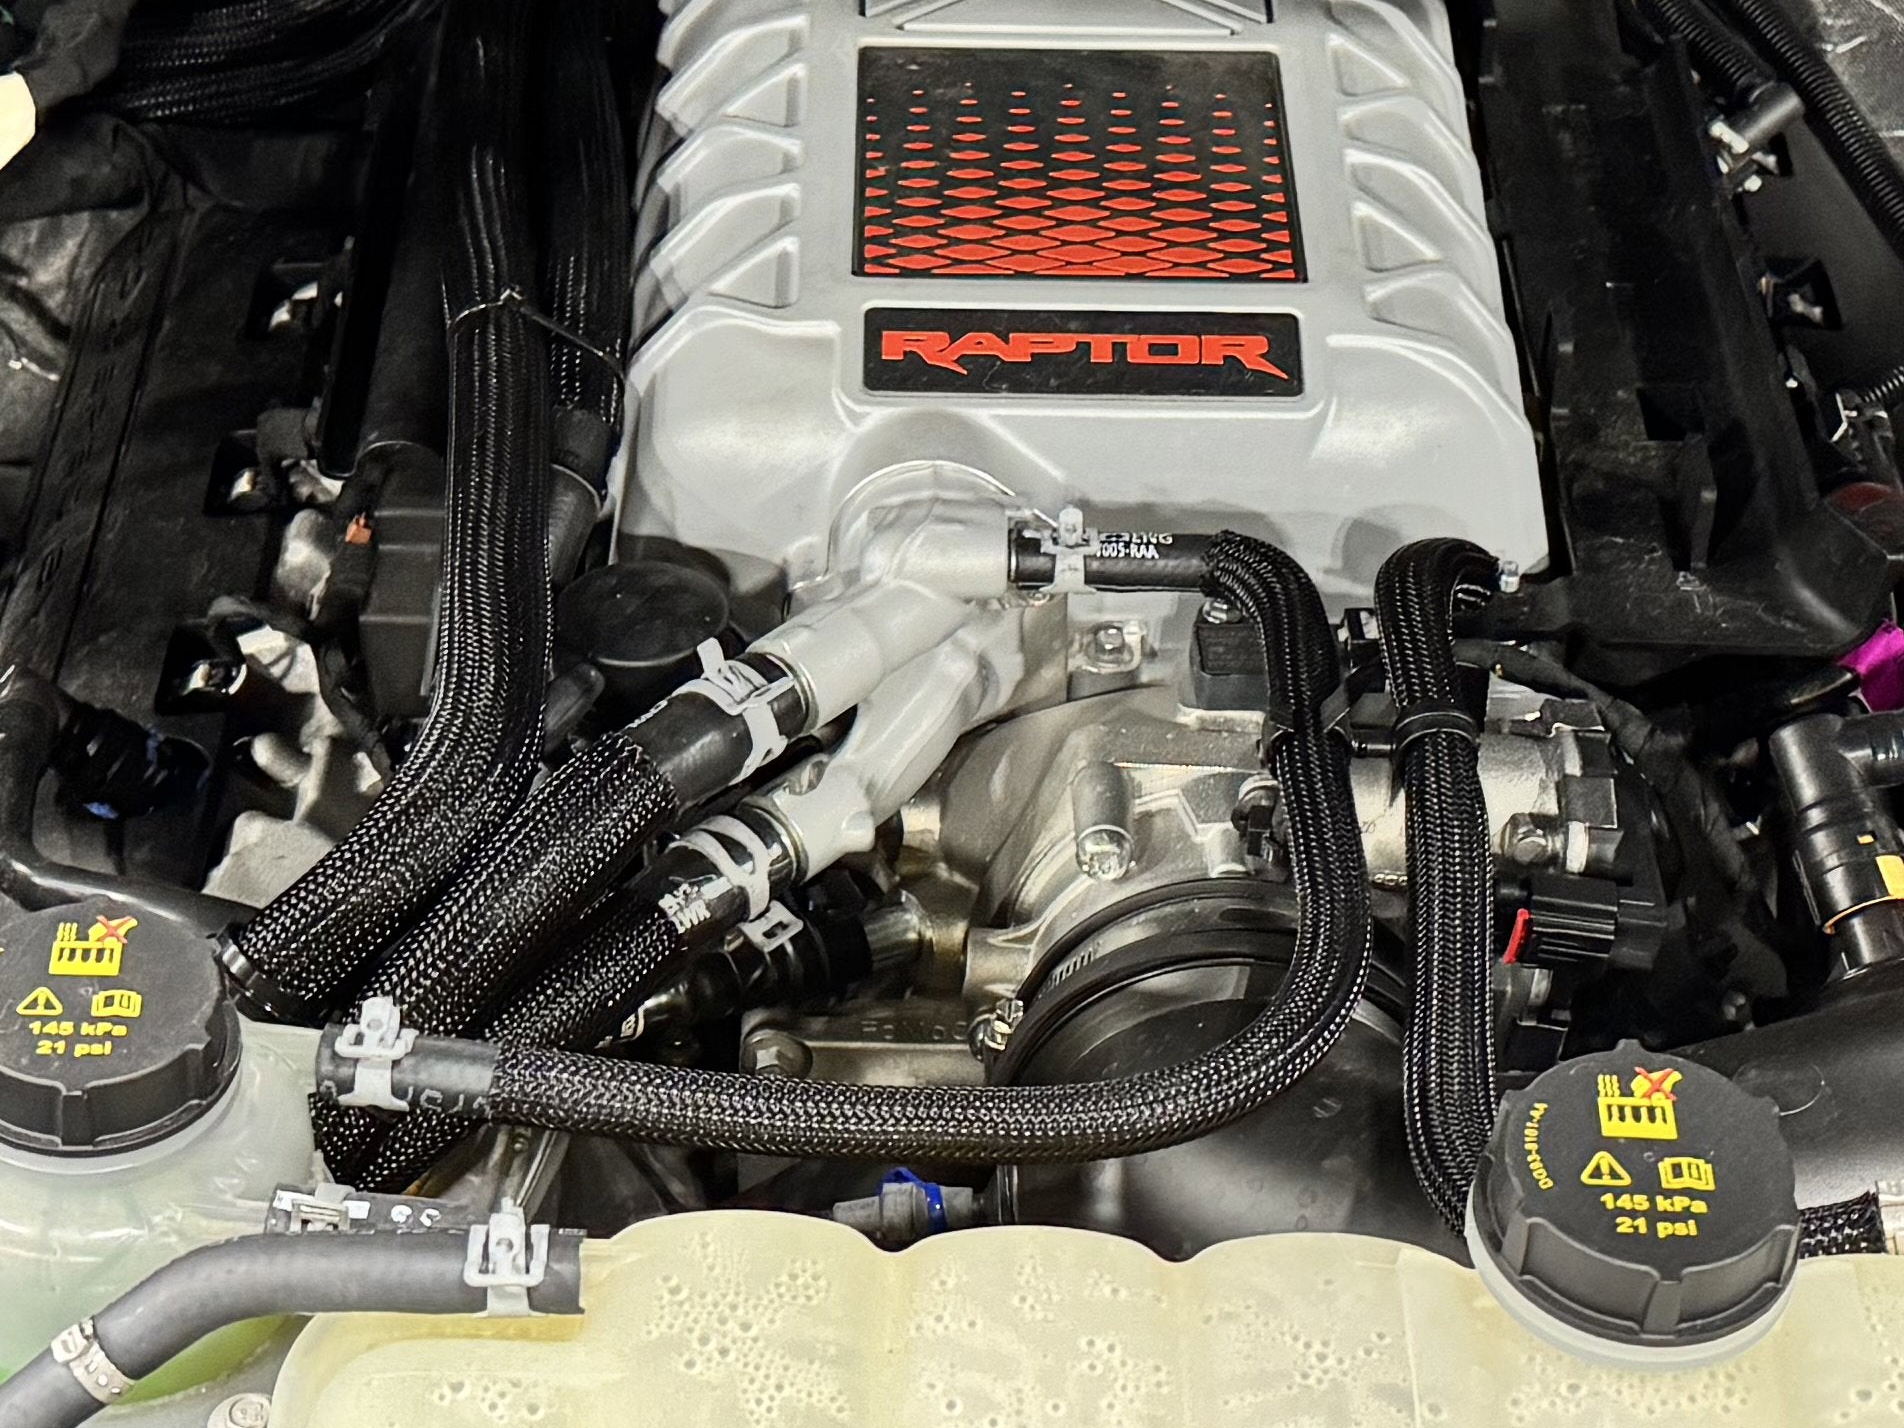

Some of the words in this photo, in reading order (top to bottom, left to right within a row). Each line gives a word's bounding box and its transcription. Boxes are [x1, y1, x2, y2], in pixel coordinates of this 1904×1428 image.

[882, 331, 1288, 379] RAPTOR
[29, 1021, 74, 1036] 145
[80, 1021, 128, 1037] kPa
[36, 1040, 66, 1055] 21
[73, 1040, 112, 1058] psi
[1600, 1192, 1650, 1211] 145
[1656, 1195, 1708, 1213] kPa
[1615, 1217, 1648, 1234] 21
[1656, 1219, 1698, 1238] psi
